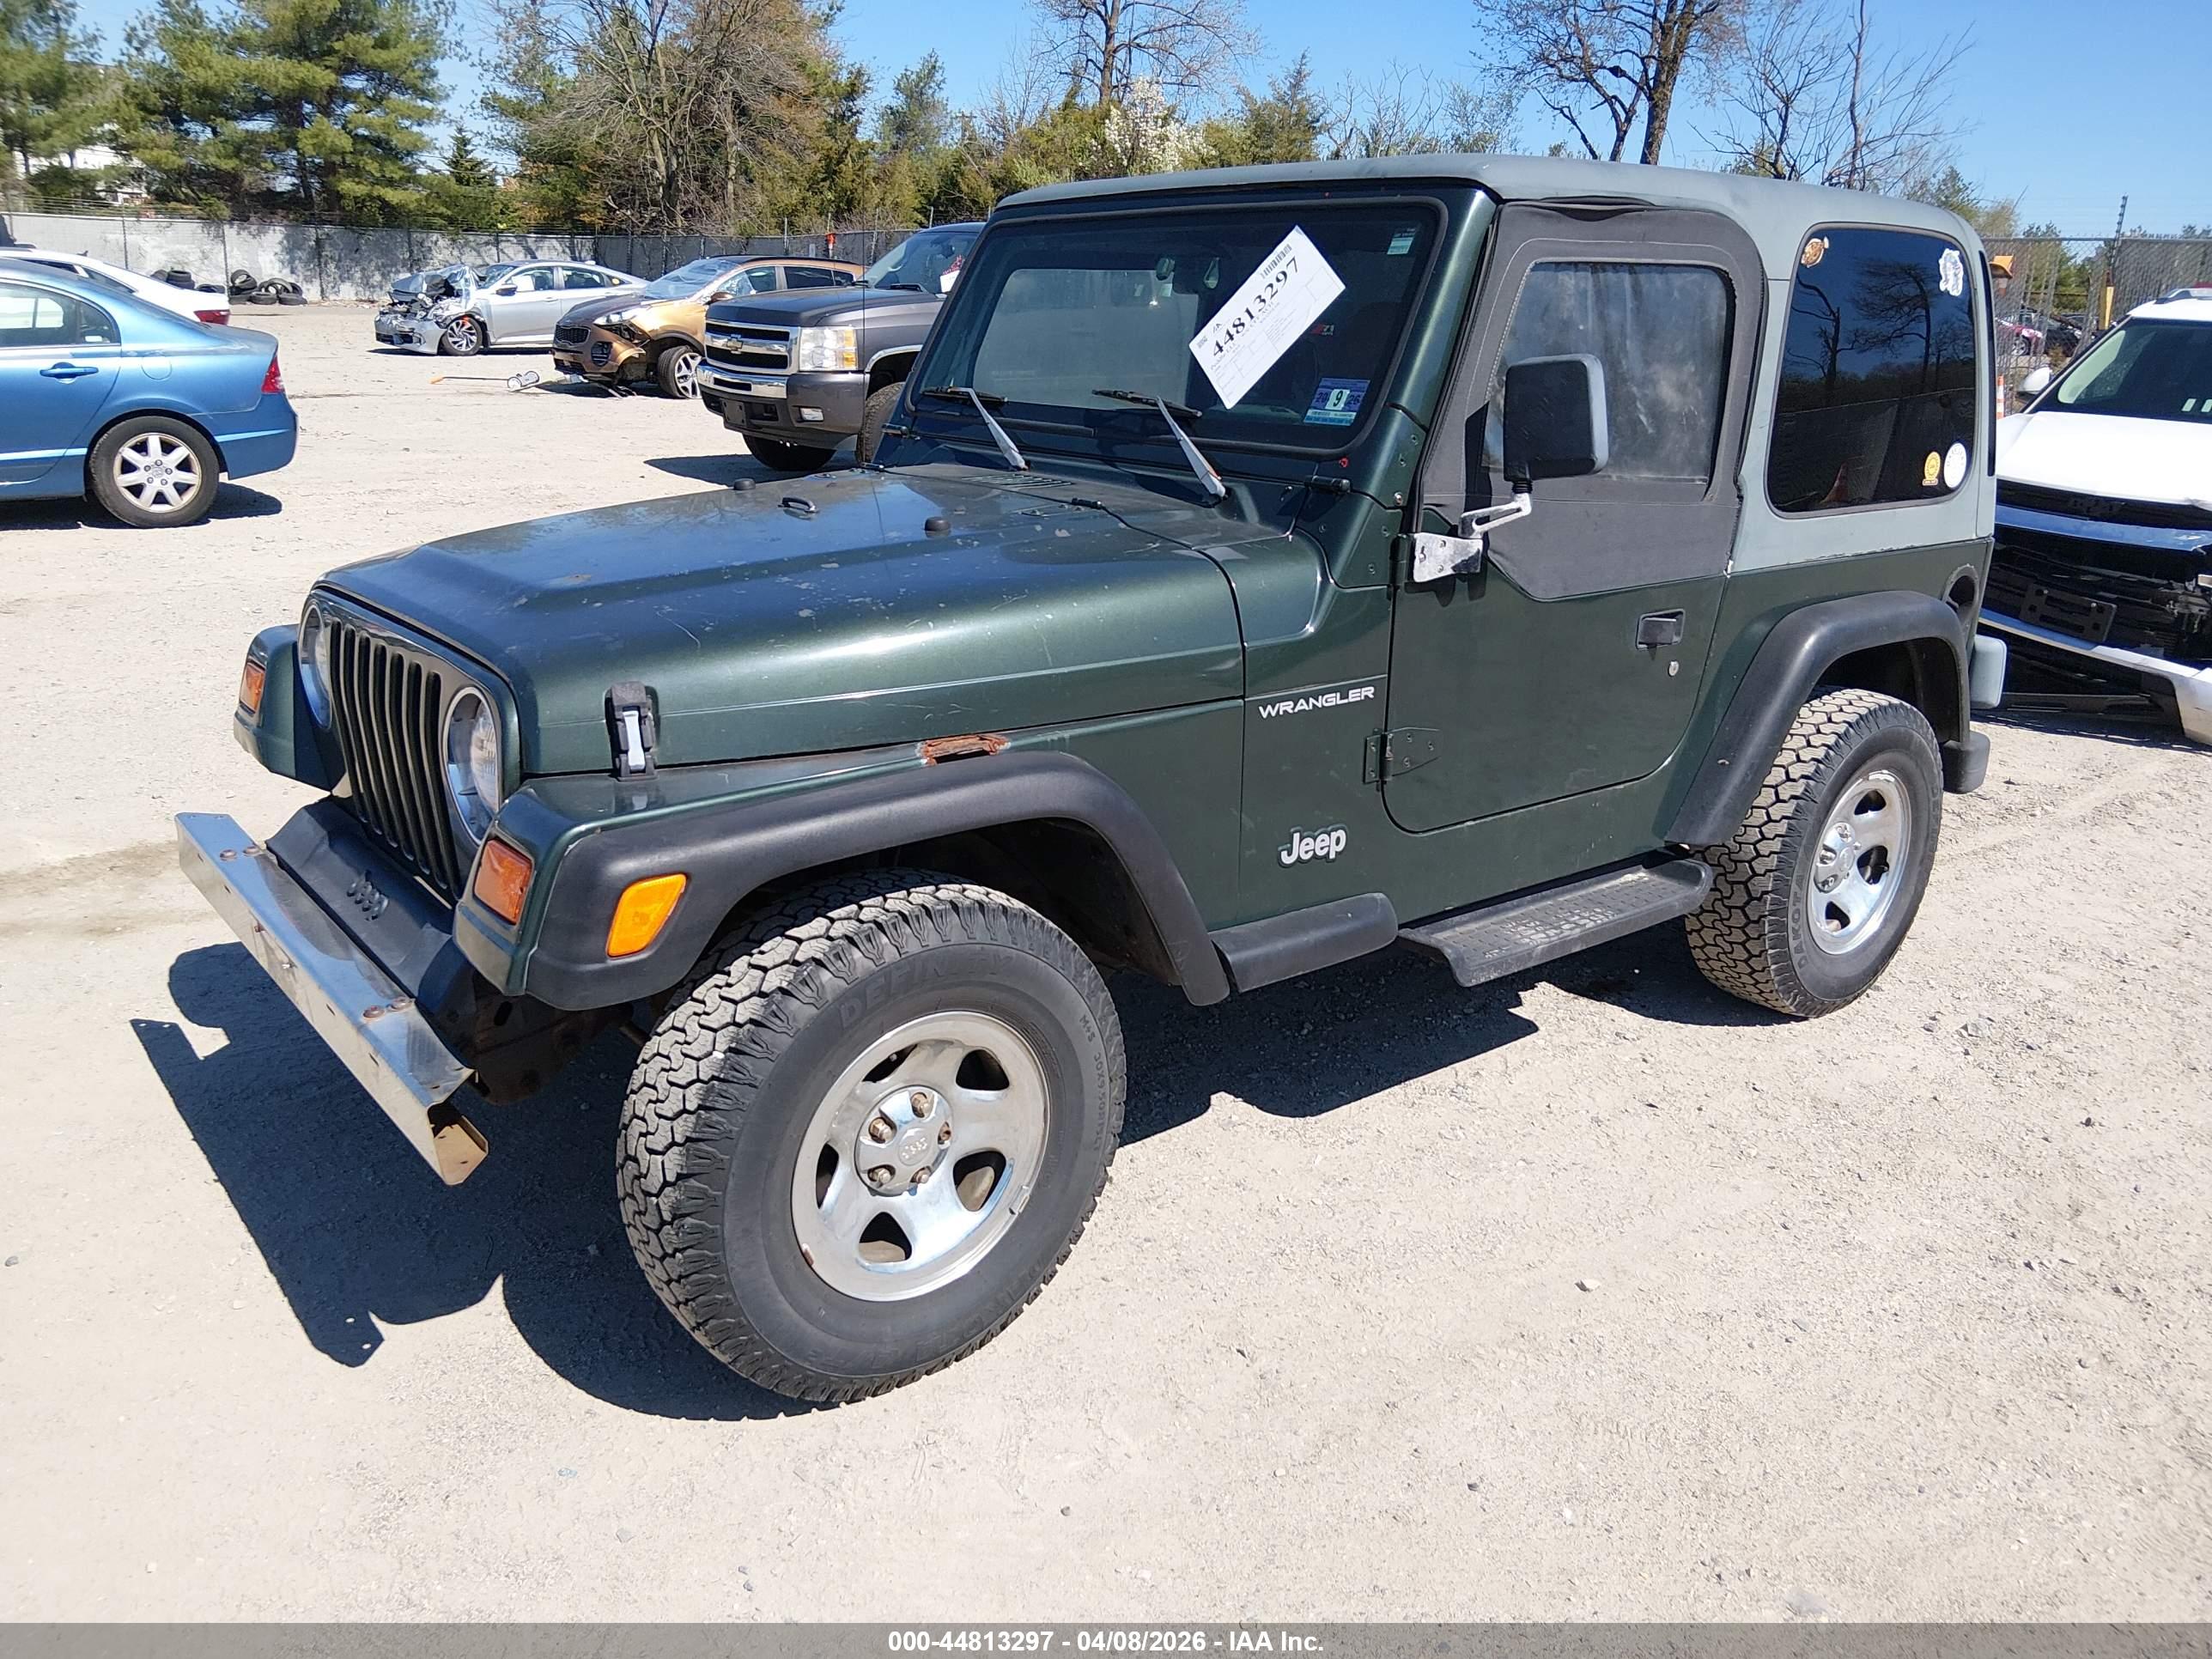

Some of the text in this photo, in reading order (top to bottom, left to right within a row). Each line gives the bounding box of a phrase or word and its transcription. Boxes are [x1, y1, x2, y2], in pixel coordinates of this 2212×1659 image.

[1212, 256, 1299, 358] 44813297
[1333, 390, 1344, 407] 9
[1258, 686, 1375, 719] WRANGLER
[1279, 828, 1347, 866] Jeep
